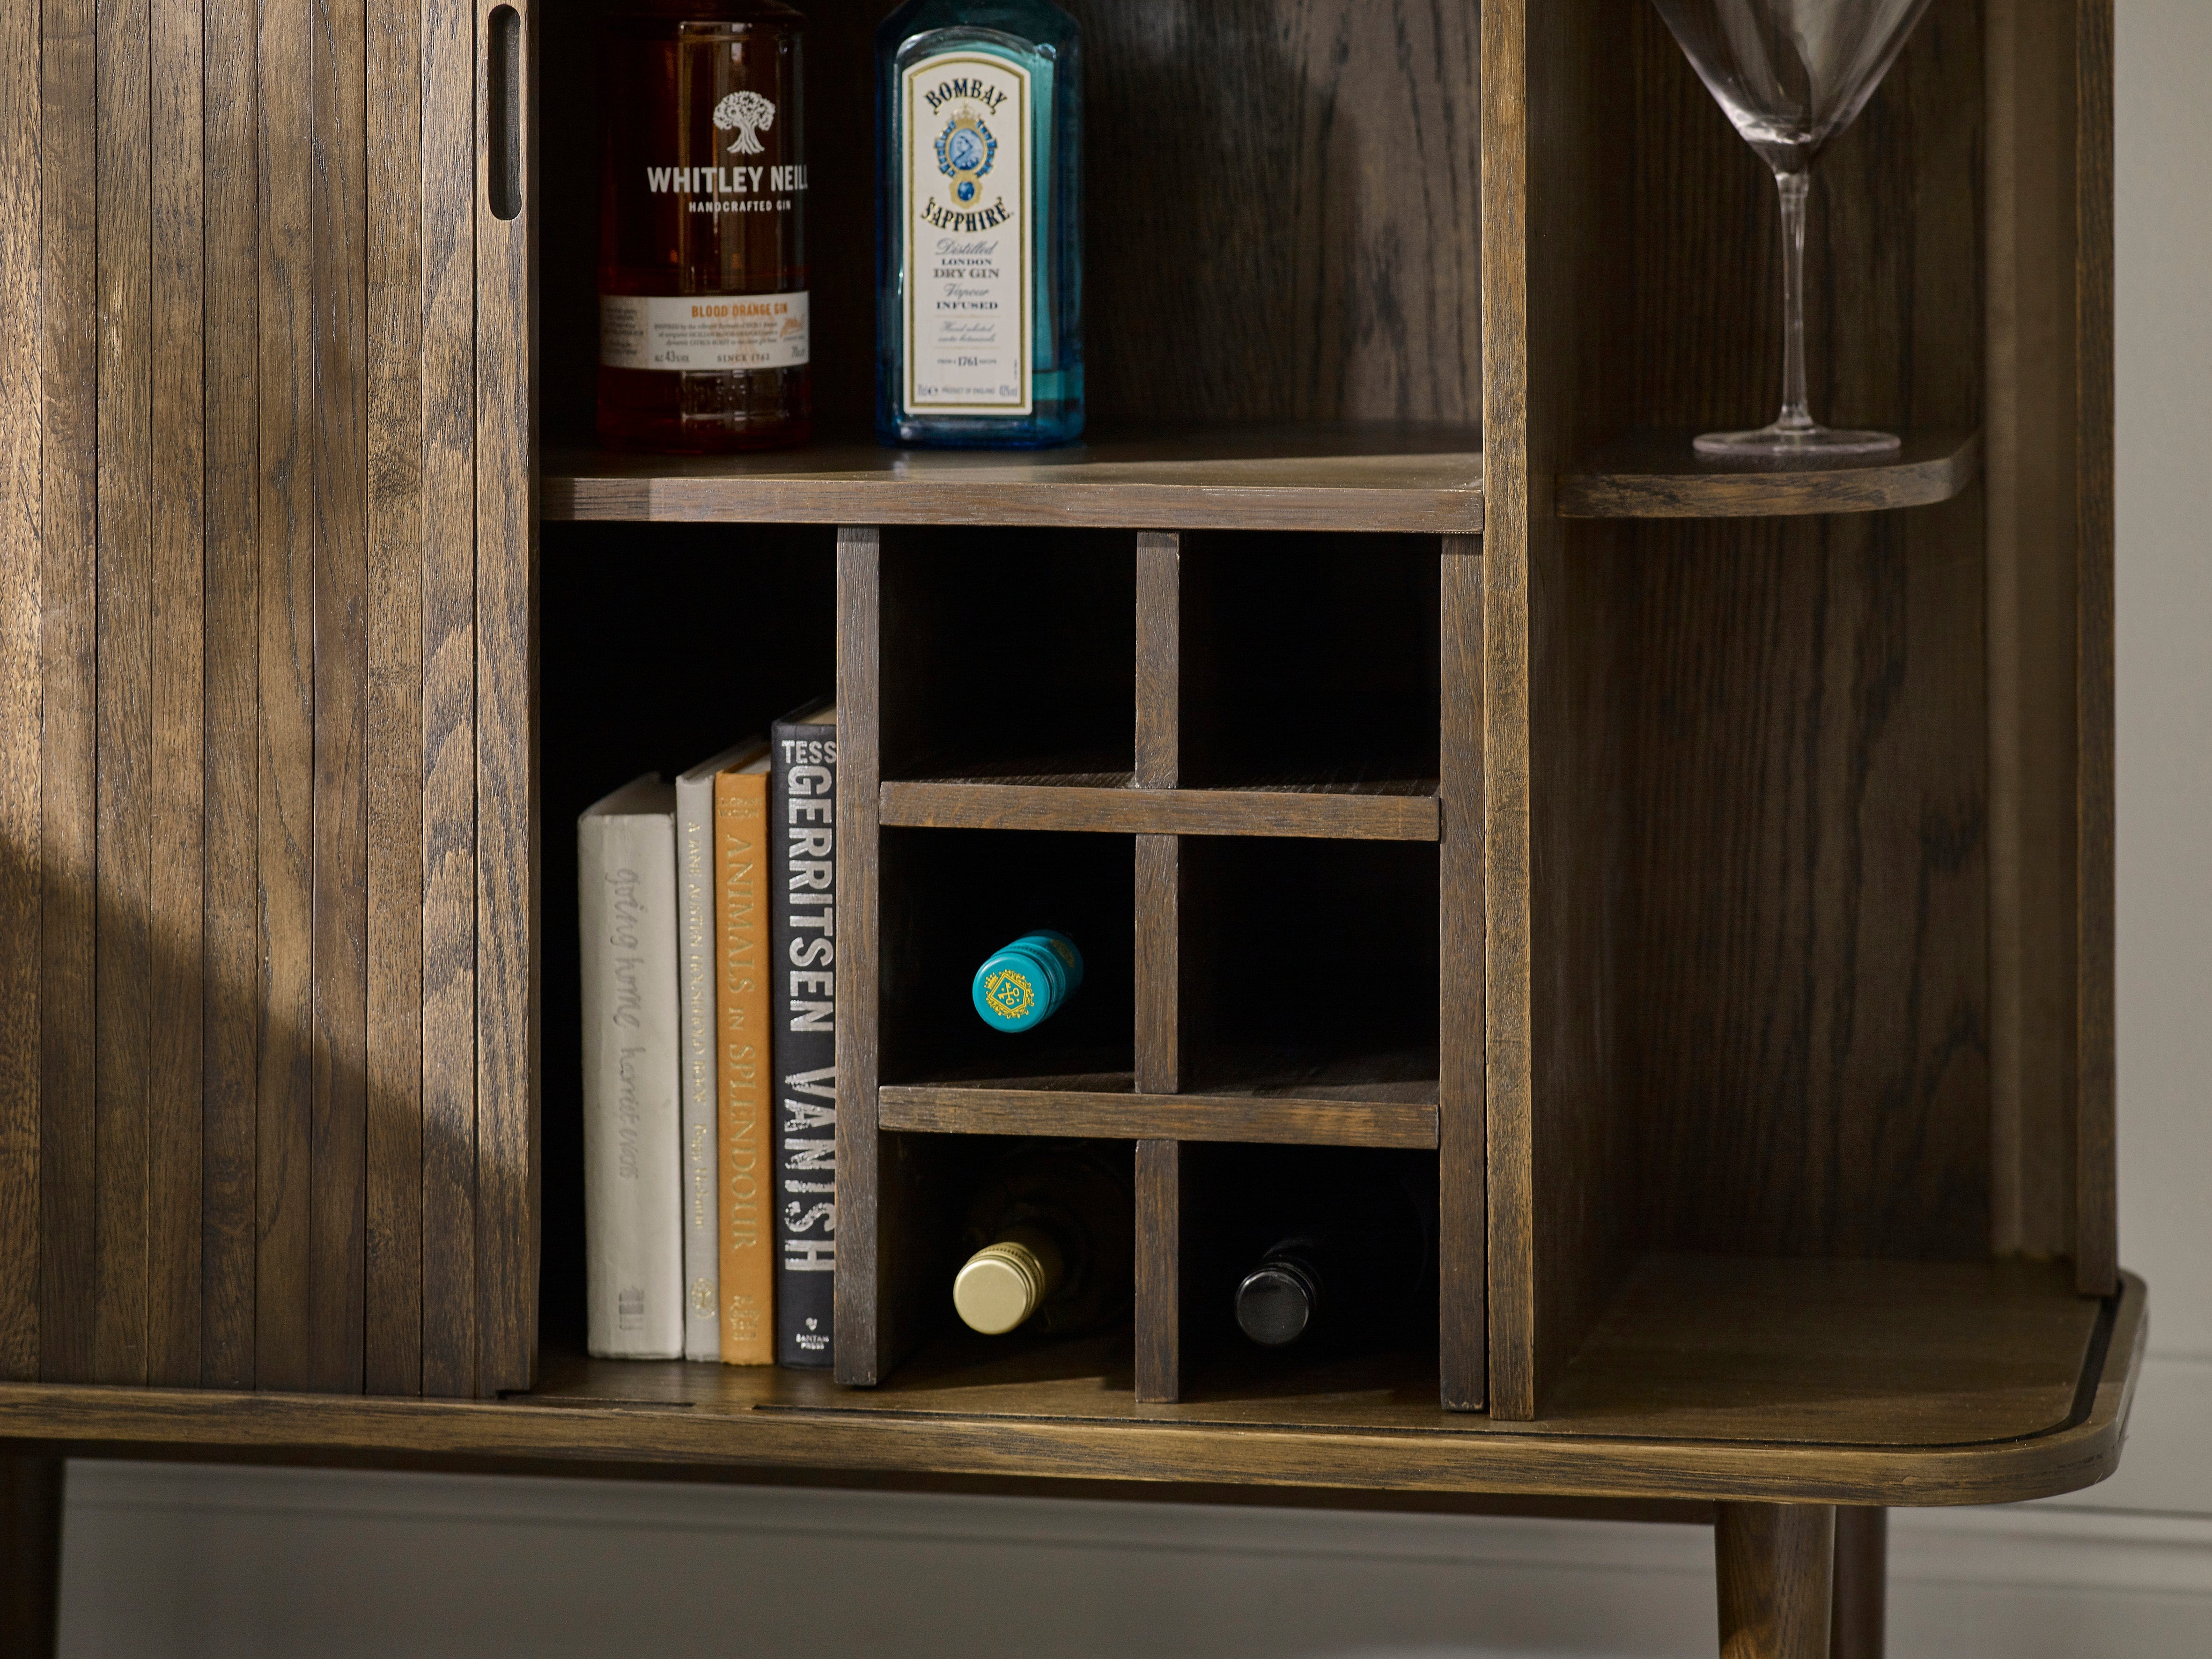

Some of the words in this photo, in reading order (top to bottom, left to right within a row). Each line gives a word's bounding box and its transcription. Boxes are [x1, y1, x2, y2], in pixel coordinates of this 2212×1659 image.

[924, 78, 1008, 115] BOMBAY
[647, 166, 763, 193] WHITLEY
[689, 200, 772, 213] HANDCRAFTED
[776, 199, 791, 211] GIN
[921, 196, 1010, 232] SAPPHIRE
[935, 237, 998, 255] Distilled
[934, 269, 966, 278] DRY
[970, 268, 999, 278] GIN
[943, 283, 989, 299] Vapour
[692, 305, 728, 317] BLOOD
[732, 304, 772, 317] ORANGE
[774, 302, 789, 315] GIN
[717, 354, 748, 362] SINCE
[958, 356, 978, 366] 1761
[782, 740, 837, 764] TESS
[688, 821, 700, 833] A
[688, 839, 702, 877] JANE
[605, 869, 645, 950] going
[727, 834, 755, 993] ANIMALS
[788, 765, 833, 1032] GERRITSEN
[688, 883, 704, 948] AUSTEN
[612, 957, 644, 1028] home
[690, 953, 706, 1055] HOUSEHOLD
[729, 1007, 744, 1031] IN
[729, 1044, 757, 1251] SPLENDOUR
[784, 1066, 835, 1271] VANISH
